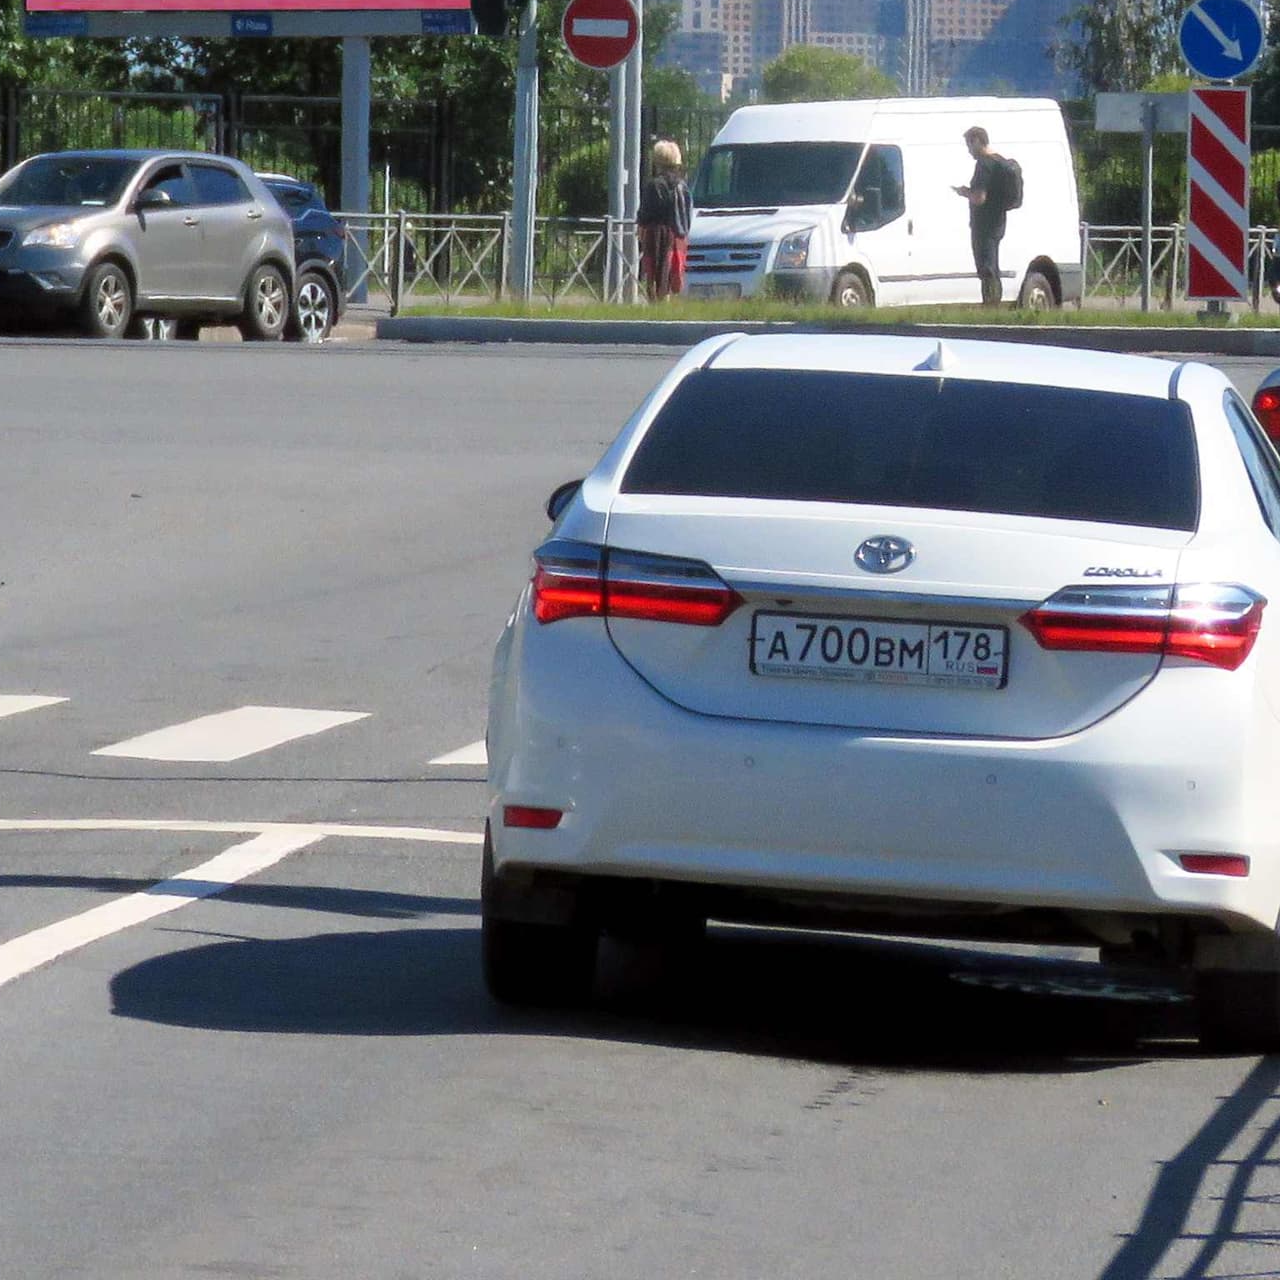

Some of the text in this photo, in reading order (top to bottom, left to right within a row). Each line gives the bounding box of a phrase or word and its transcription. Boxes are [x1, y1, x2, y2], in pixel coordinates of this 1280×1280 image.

[1083, 566, 1163, 578] COROLLA
[933, 630, 991, 661] 178
[945, 660, 976, 674] RUS
